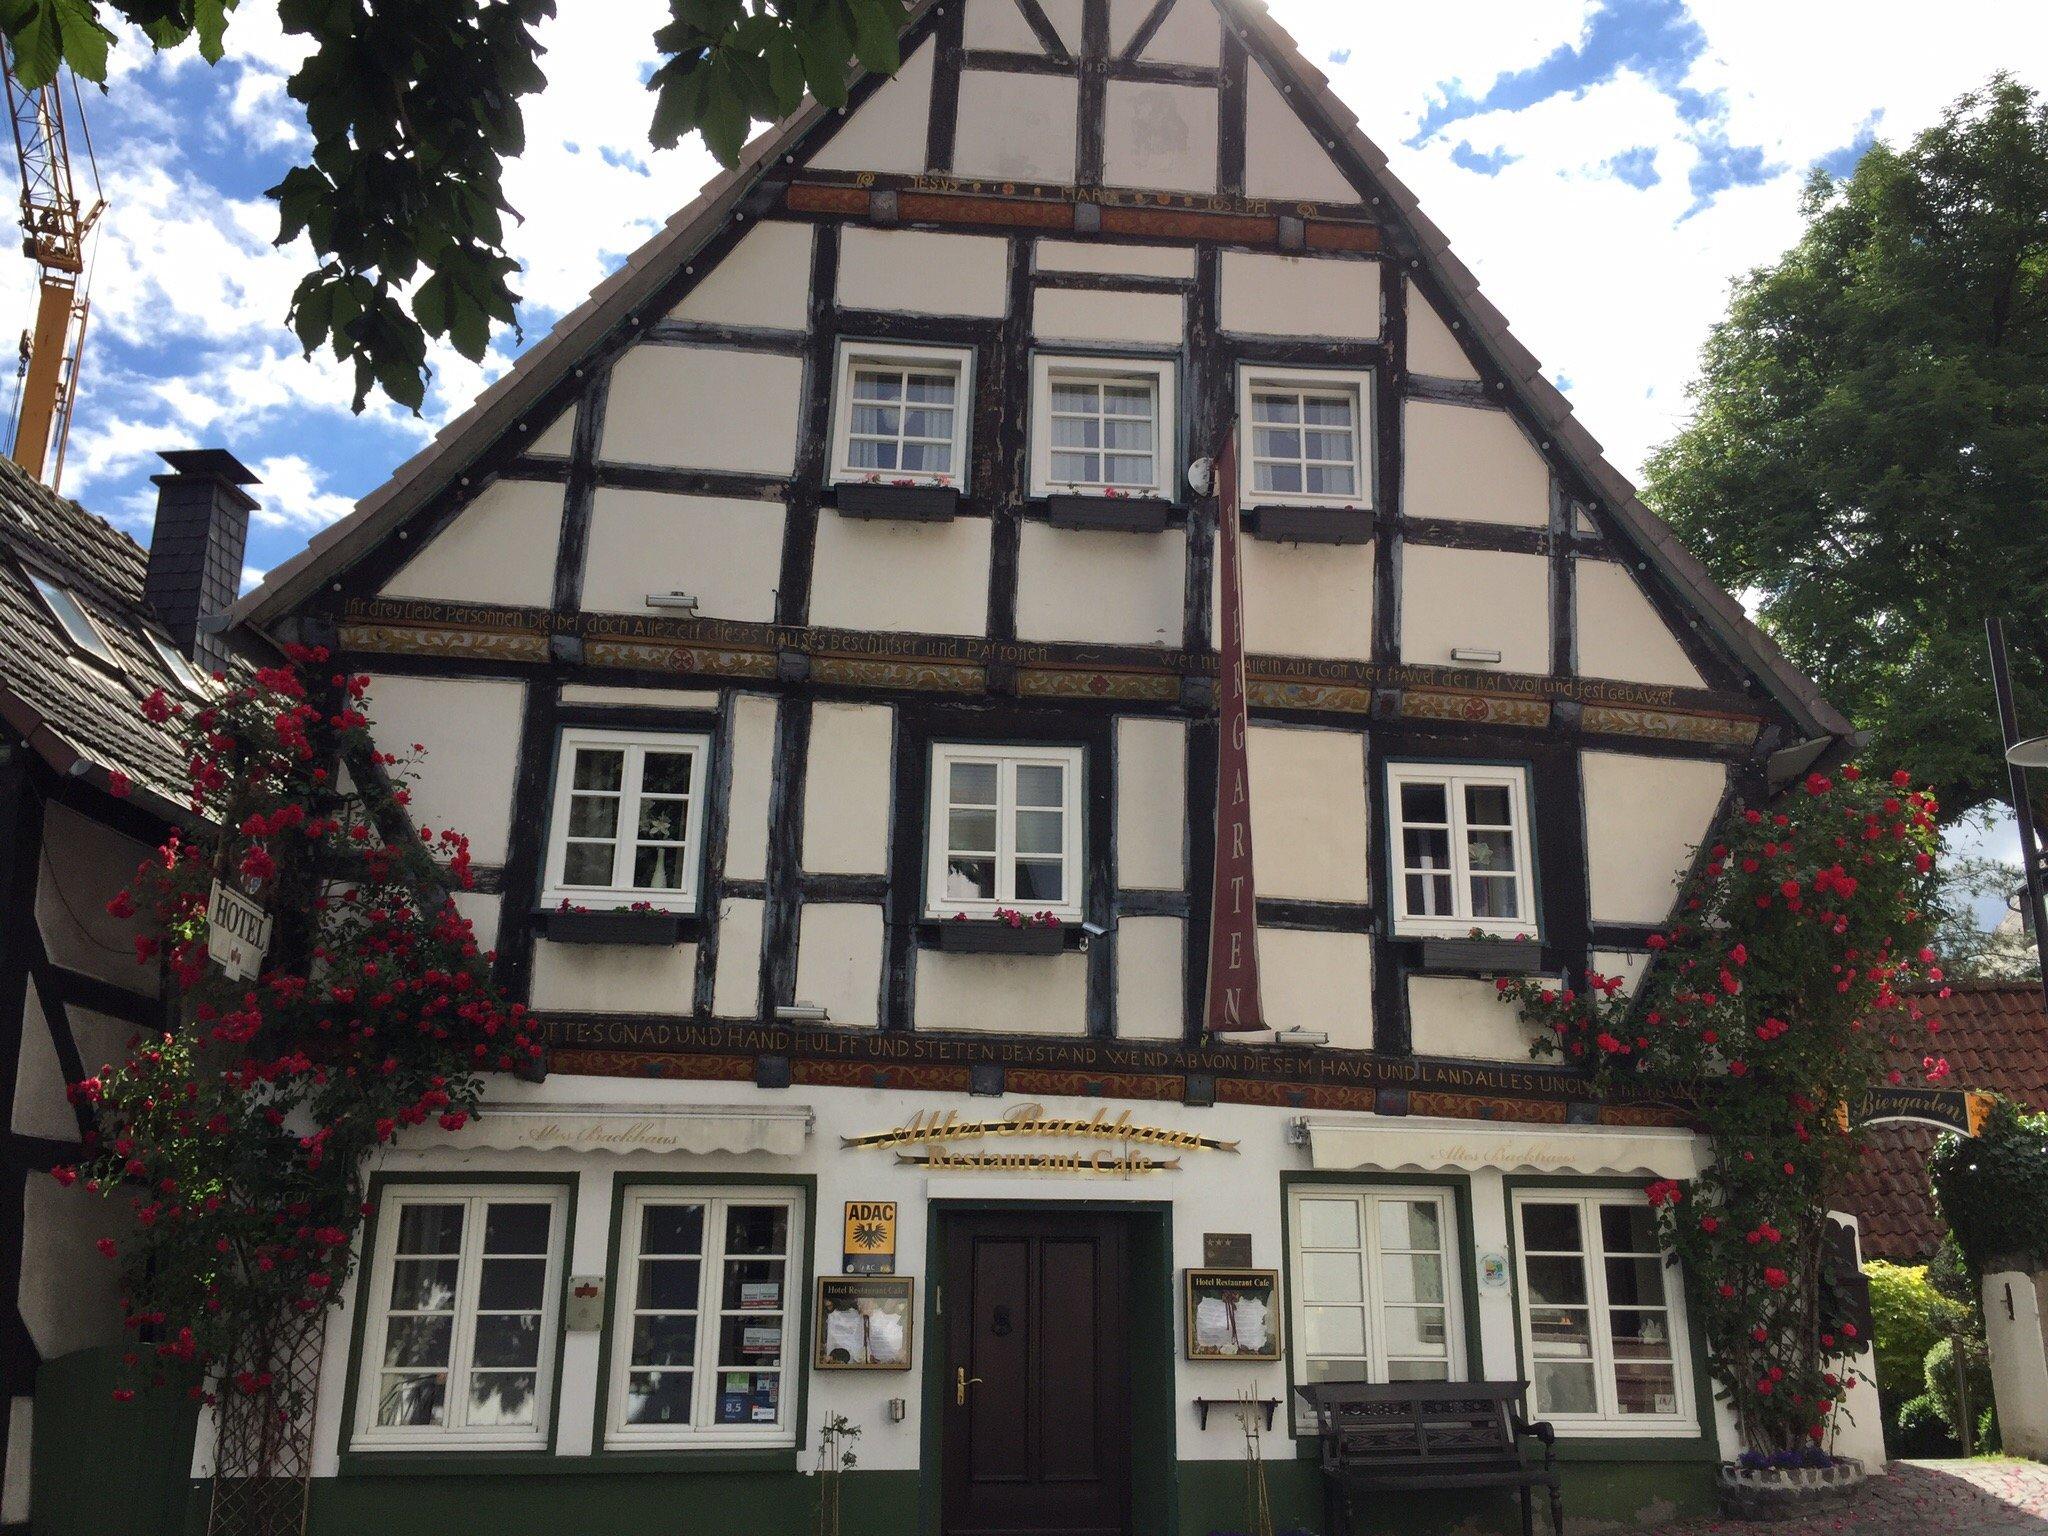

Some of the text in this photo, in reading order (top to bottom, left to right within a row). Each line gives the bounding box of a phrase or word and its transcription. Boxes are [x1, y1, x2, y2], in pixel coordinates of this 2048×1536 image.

[214, 893, 264, 951] HOTEL
[675, 1025, 722, 1047] UND
[727, 1027, 789, 1051] HAND
[868, 1036, 911, 1057] UND
[914, 1039, 995, 1059] STETEN
[1002, 1043, 1097, 1065] BEYSTAND
[1202, 1053, 1238, 1071] VON
[1859, 1091, 1965, 1123] Biergarten
[876, 1102, 1203, 1151] Altes Backhaus
[926, 1145, 1082, 1172] Restaurant
[848, 1203, 894, 1222] ADAC
[827, 1285, 848, 1296] Hotel
[1195, 1277, 1215, 1287] Hotel
[1216, 1277, 1253, 1288] Restaurant
